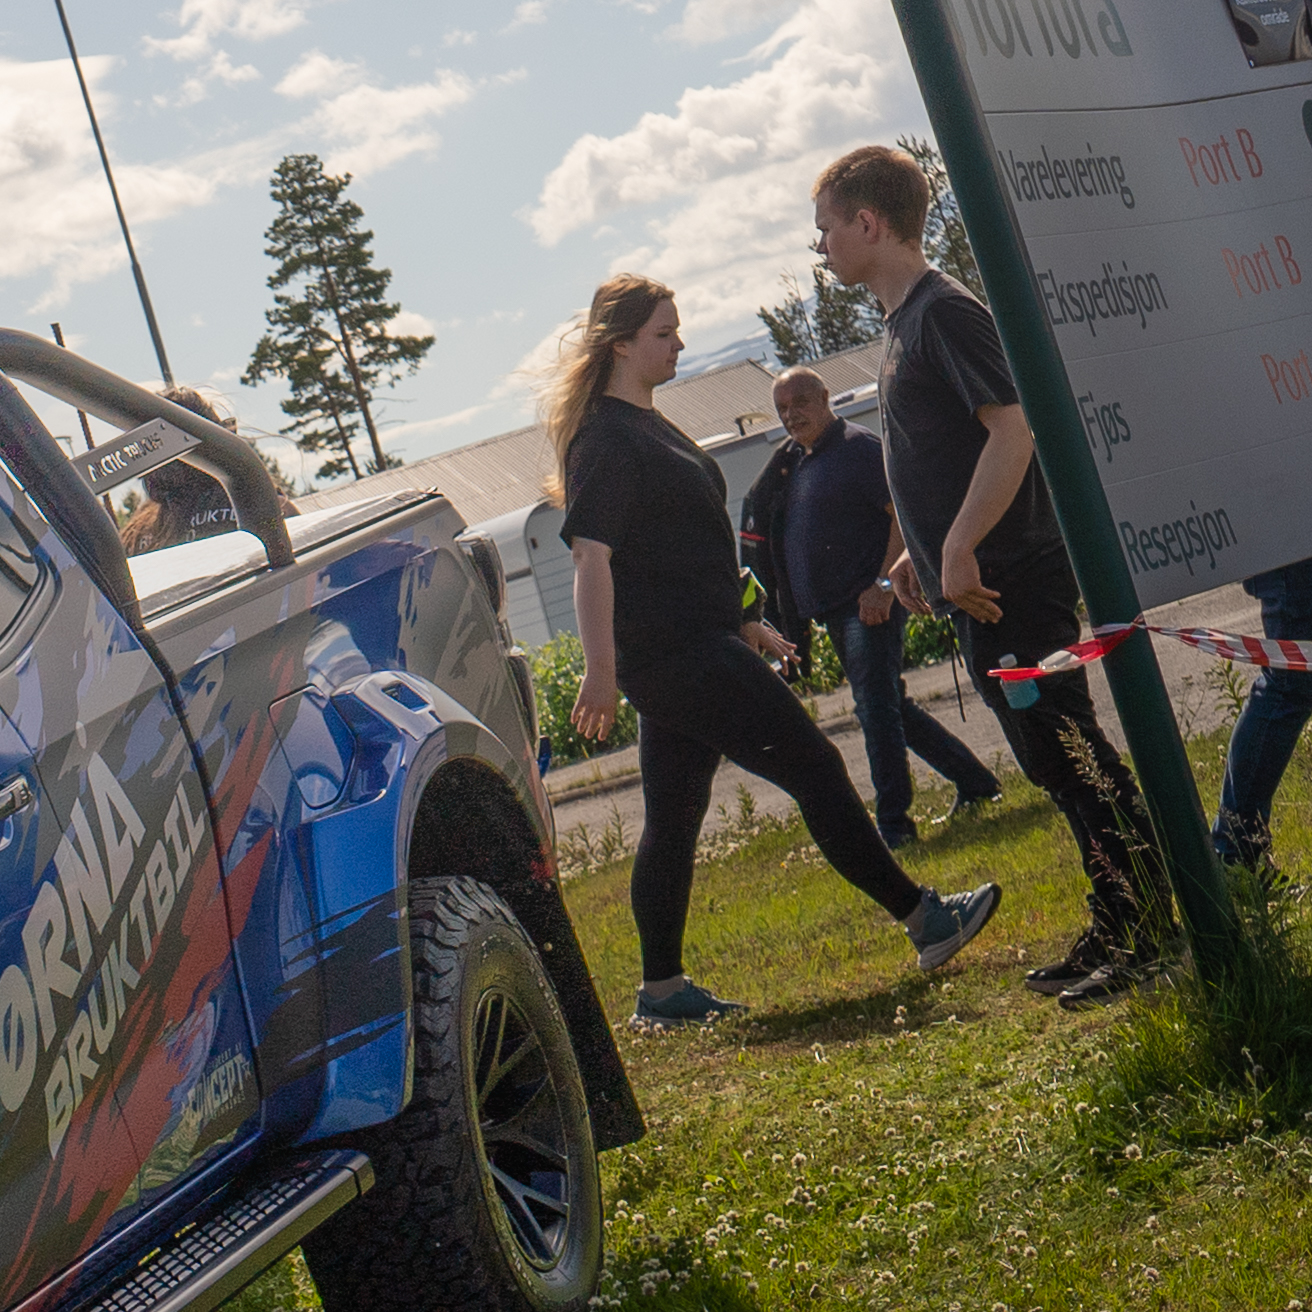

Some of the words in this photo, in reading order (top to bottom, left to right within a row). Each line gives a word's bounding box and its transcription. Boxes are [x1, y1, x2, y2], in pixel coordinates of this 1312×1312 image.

[997, 142, 1136, 209] Varelevering
[1178, 134, 1242, 187] Port
[1037, 260, 1169, 337] Ekspedisjon
[1221, 242, 1282, 298] Port
[1274, 235, 1302, 285] B
[1077, 391, 1131, 464] Fjøs
[1119, 499, 1237, 576] Resepsjon
[44, 780, 205, 1160] BRUKTBIL
